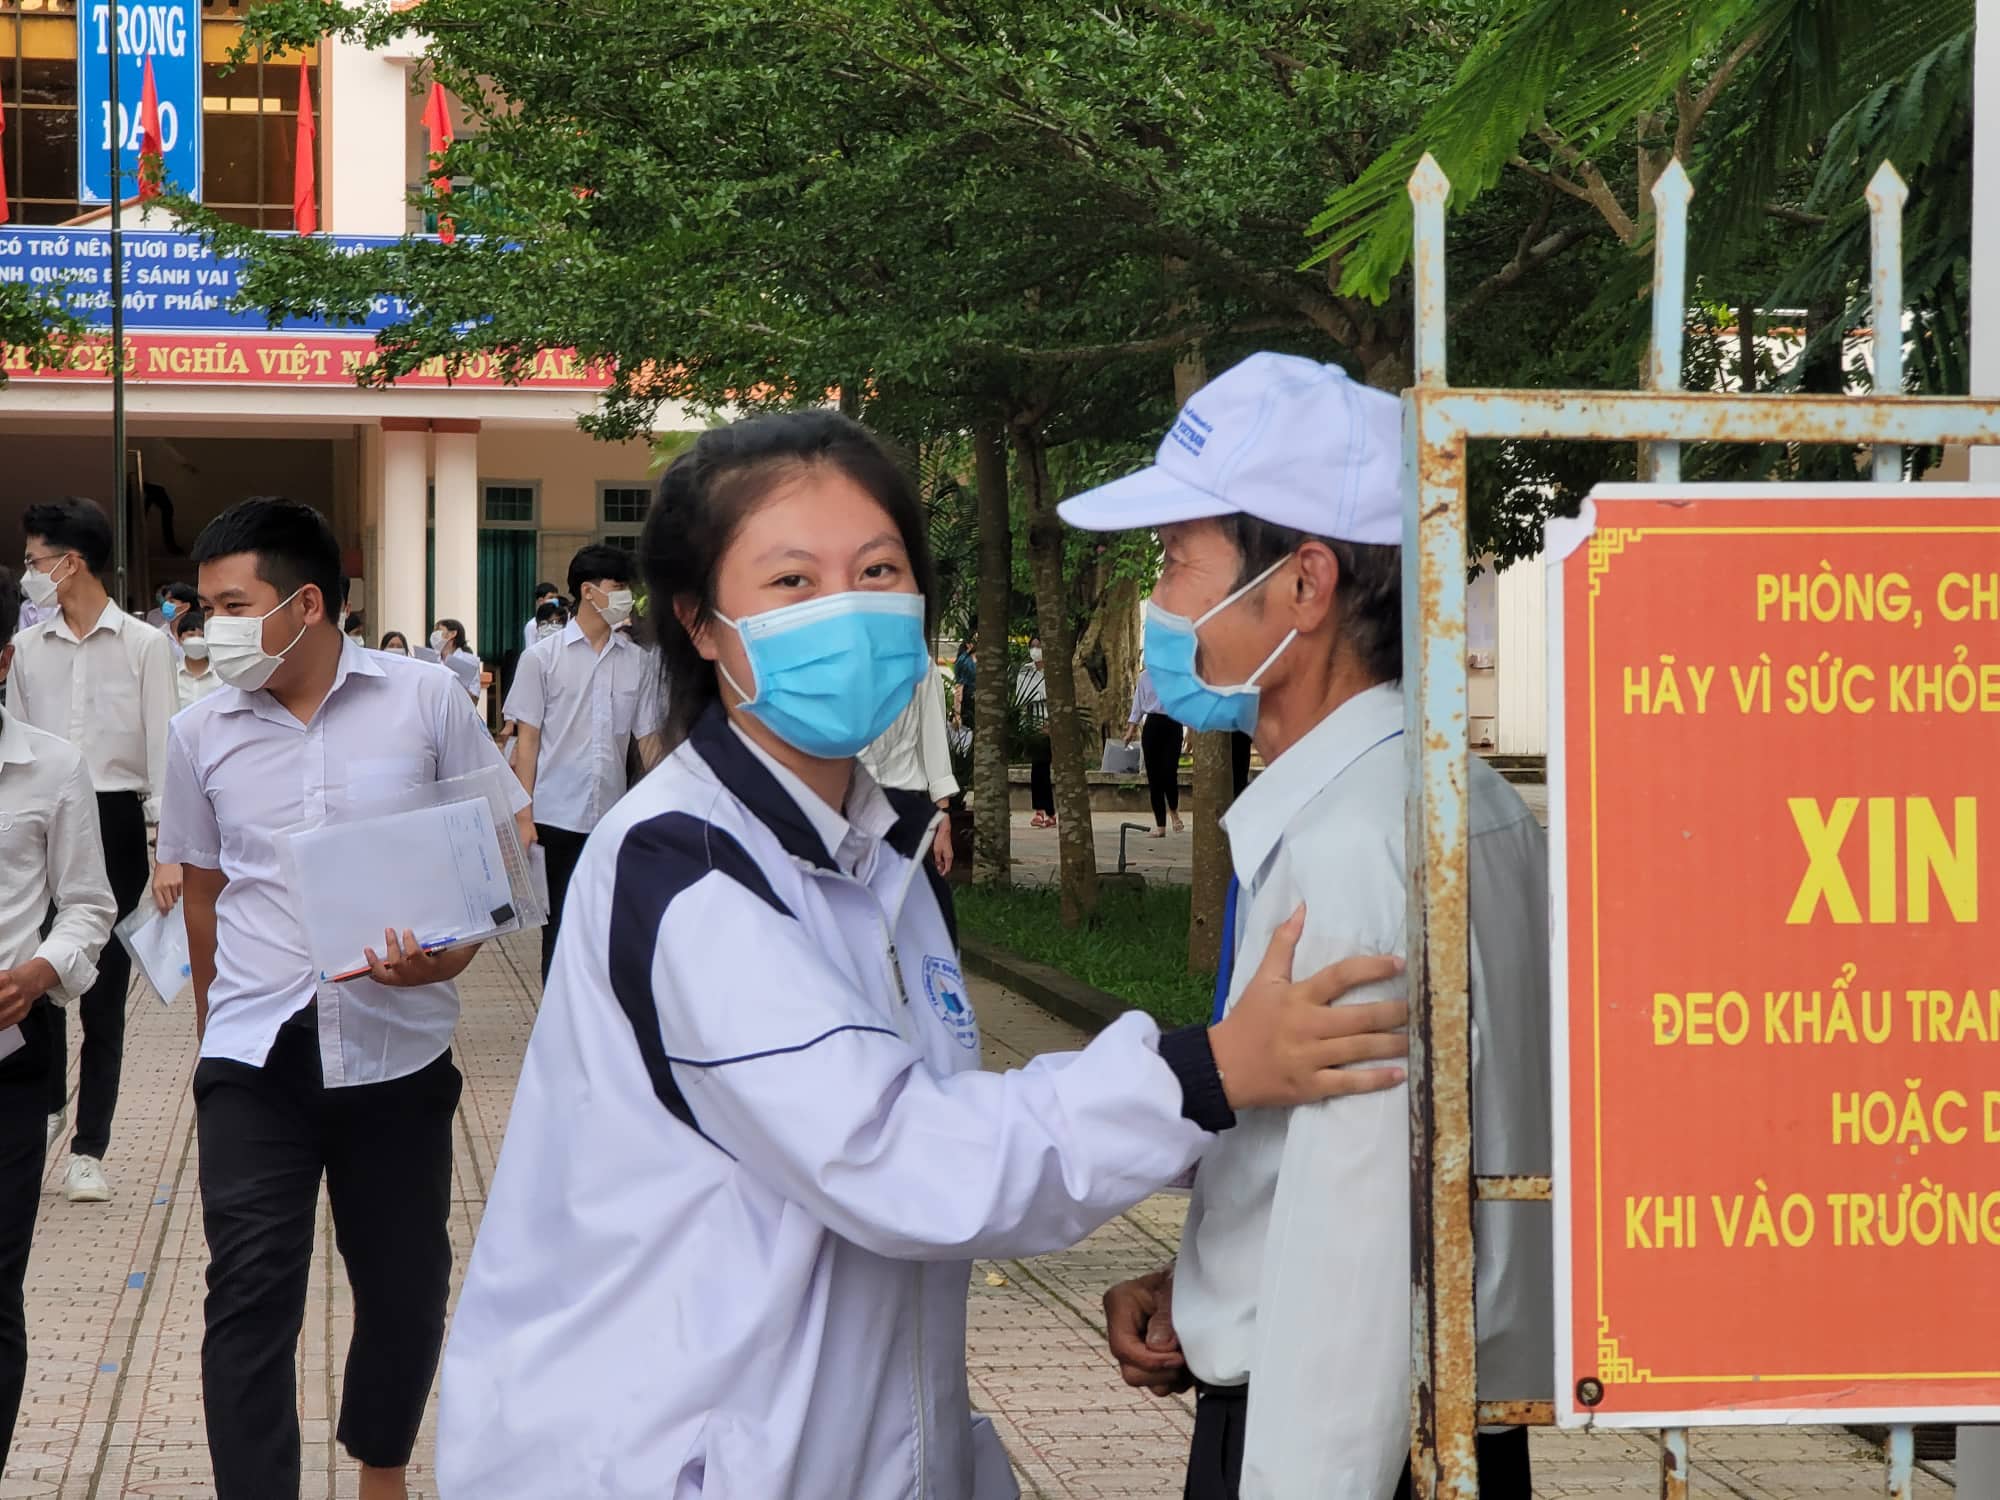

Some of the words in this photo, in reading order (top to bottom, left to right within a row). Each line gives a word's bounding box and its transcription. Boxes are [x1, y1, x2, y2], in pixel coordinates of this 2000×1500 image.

[93, 4, 186, 68] TRỌNG
[27, 235, 70, 257] TRỞ
[122, 240, 167, 259] TƯƠI
[137, 265, 190, 285] SÁNH
[196, 269, 229, 285] VAI
[148, 342, 249, 374] NGHĨA
[256, 343, 331, 380] VIỆT
[1757, 559, 1923, 629] PHÒNG,
[1937, 572, 1999, 621] CH
[1623, 653, 1715, 714] HÃY
[1729, 652, 1771, 714] VÌ
[1785, 651, 1875, 714] SỨC
[1889, 643, 2000, 714] KHỎE
[1785, 796, 1978, 924] XIN
[1652, 990, 1750, 1046] ĐEO
[1764, 962, 1892, 1044] KHẨU
[1832, 1077, 1968, 1155] HOẶC
[1625, 1195, 1697, 1249] KHI
[1711, 1178, 1815, 1248] VÀO
[1827, 1176, 2000, 1247] TRƯỜNG
